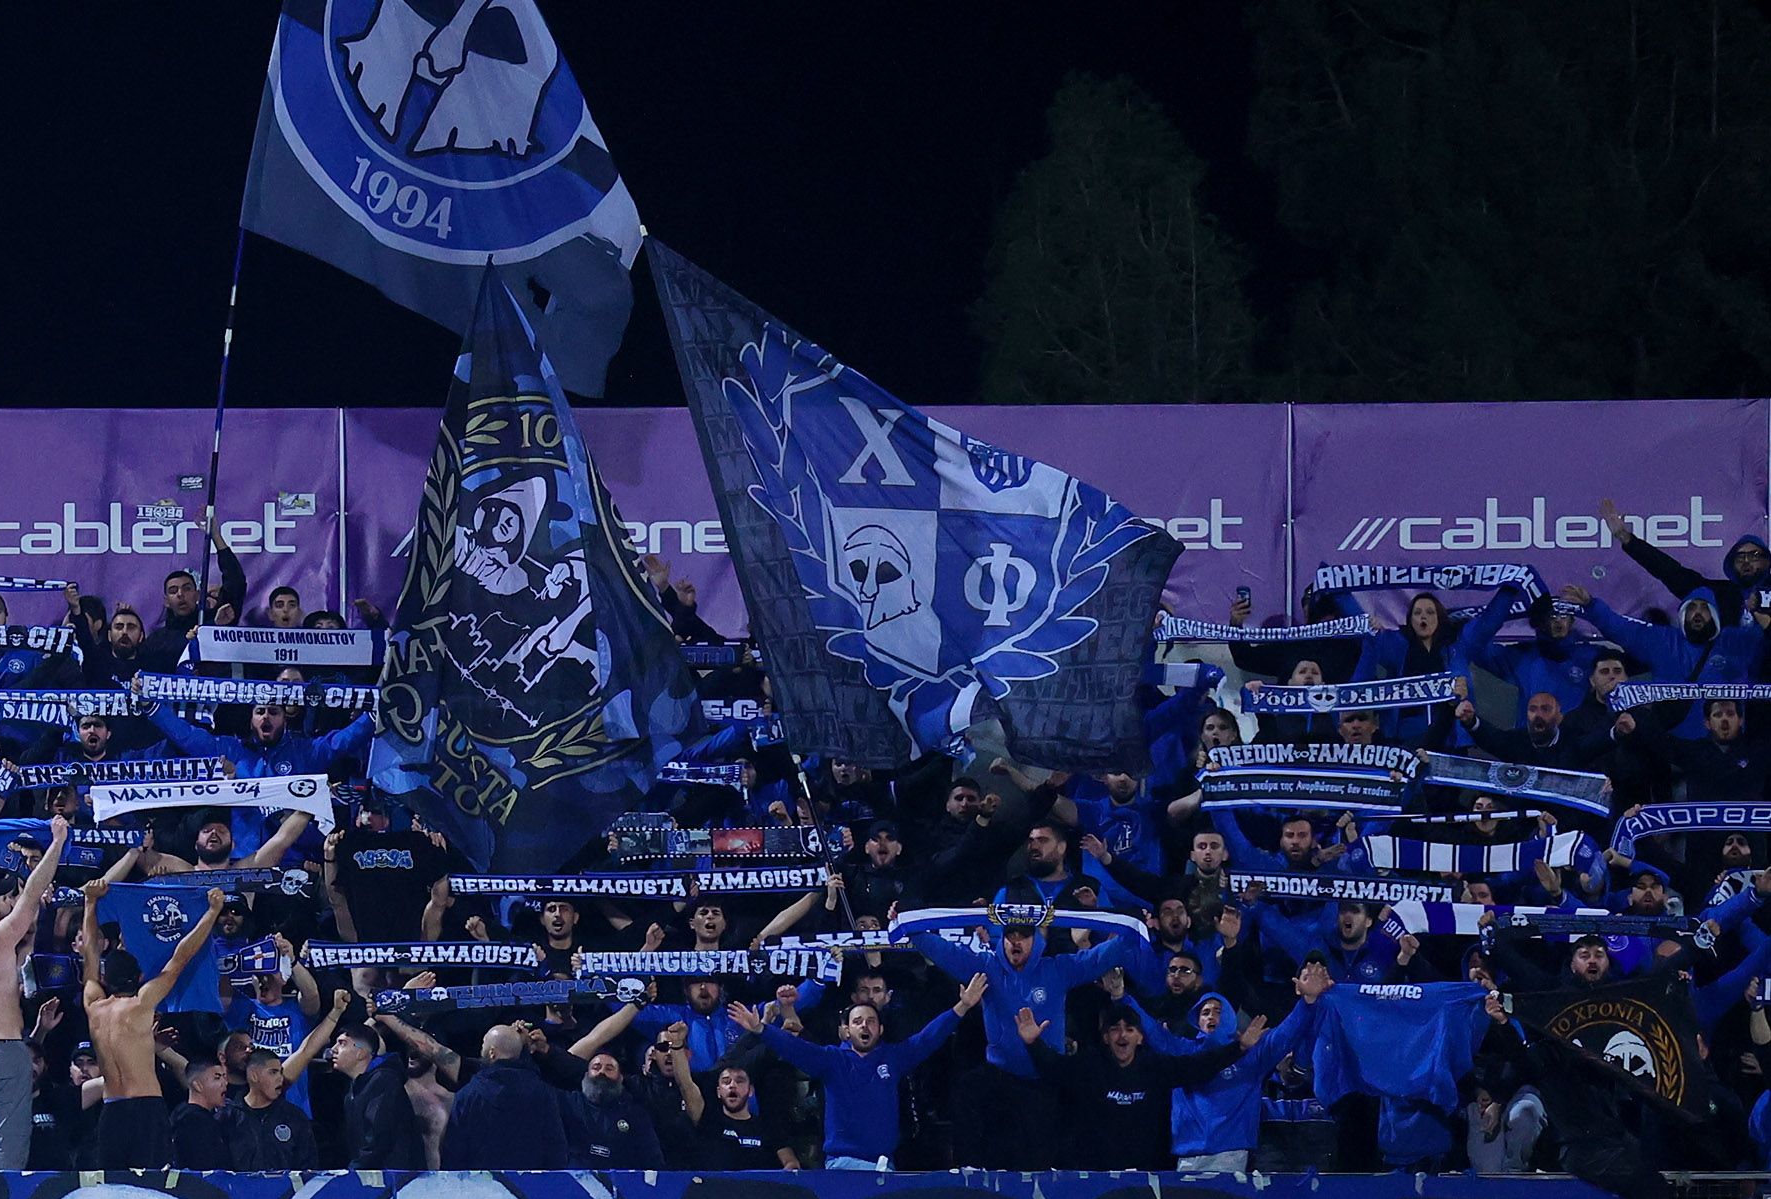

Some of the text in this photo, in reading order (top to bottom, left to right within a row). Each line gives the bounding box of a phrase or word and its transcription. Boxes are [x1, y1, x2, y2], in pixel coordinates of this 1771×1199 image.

[350, 156, 452, 240] 1994
[520, 413, 563, 449] 10
[1399, 496, 1724, 549] cablenet
[27, 626, 74, 654] CIT
[273, 647, 300, 663] 1911
[1209, 743, 1294, 769] FREEDOM
[1309, 743, 1421, 779] FAMAGUSTA
[450, 878, 687, 898] REEDOM FAMAGUSTA
[698, 867, 829, 892] FAMAGUSTA
[1333, 879, 1453, 904] FAMAGUSTA
[309, 946, 395, 967] REEDOM
[410, 944, 539, 968] FAMAGUSTA
[584, 949, 830, 980] FAMAGUSTA CITY
[1358, 983, 1424, 1000] MAXHTEC
[1574, 1002, 1646, 1026] ΧΡΟΝΙΑ
